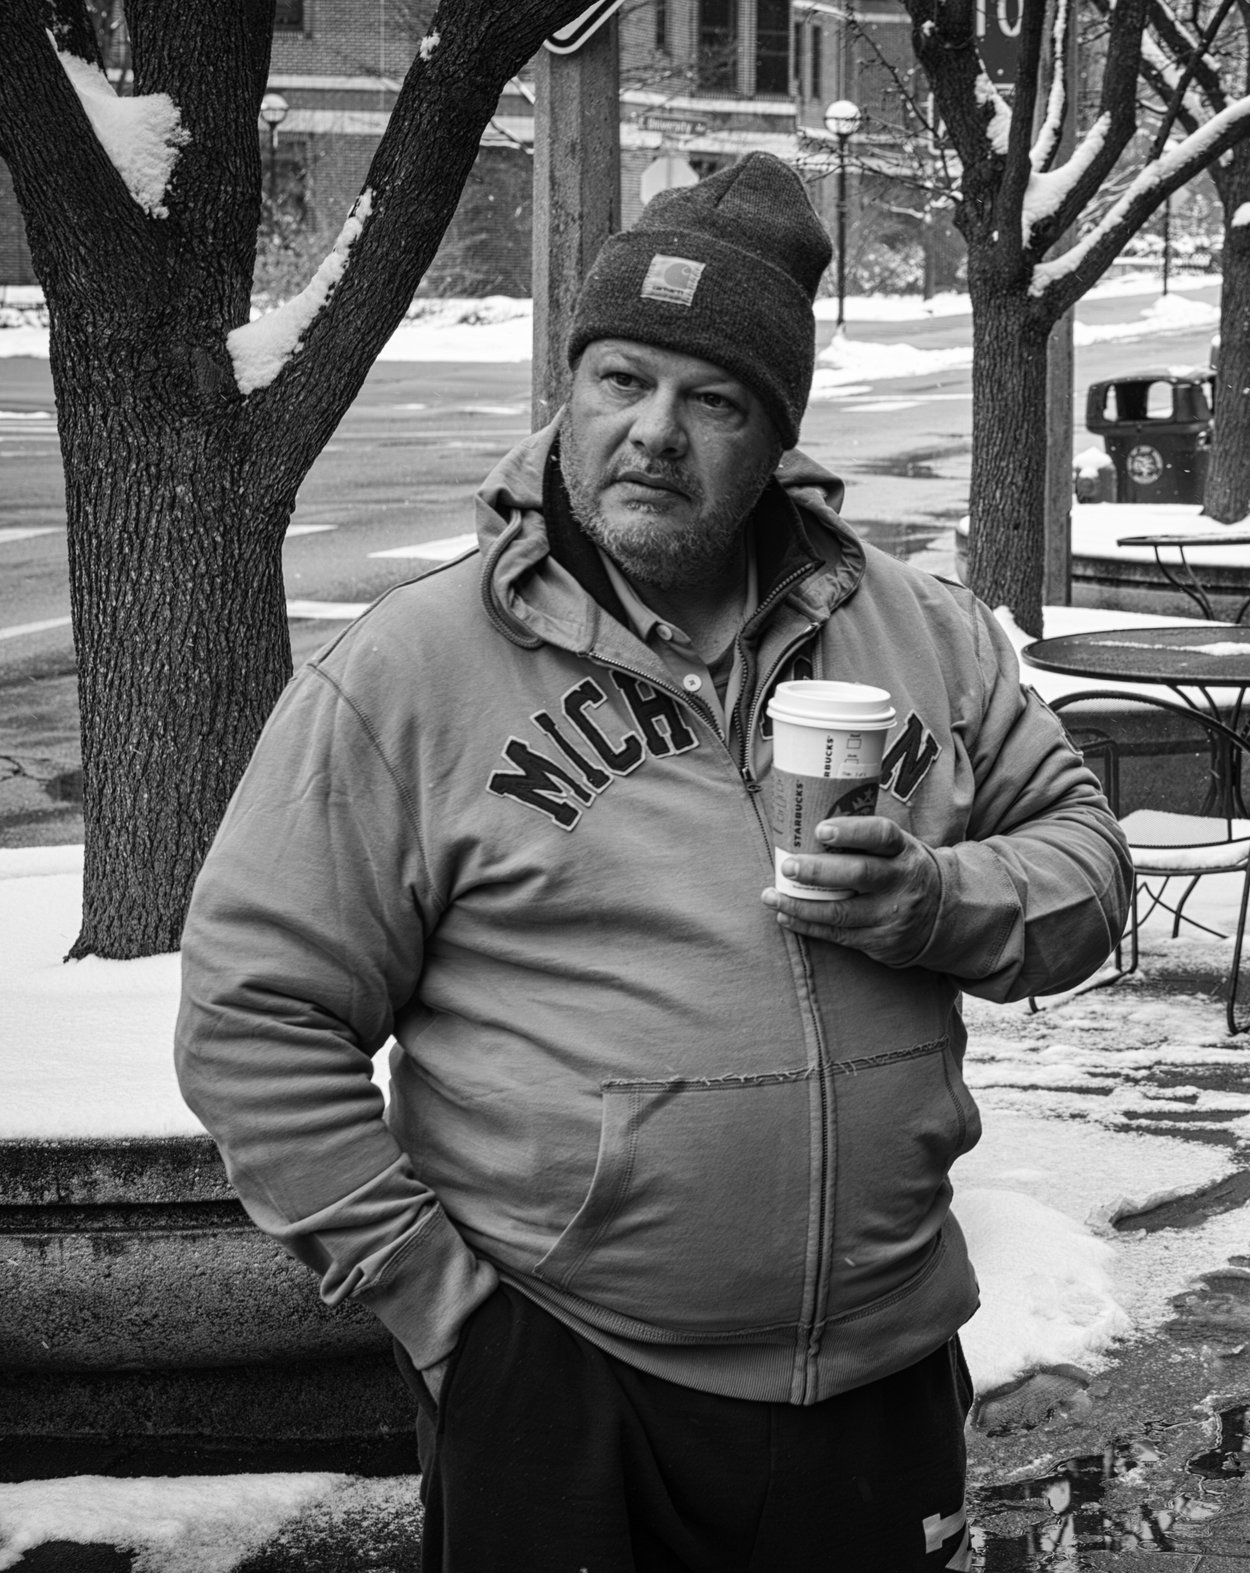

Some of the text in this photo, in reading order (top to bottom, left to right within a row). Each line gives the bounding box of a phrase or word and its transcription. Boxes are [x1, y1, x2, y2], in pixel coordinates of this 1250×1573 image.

[486, 666, 943, 832] MICHN
[823, 738, 835, 778] RBUCKS
[793, 782, 804, 848] STARBUCKS
